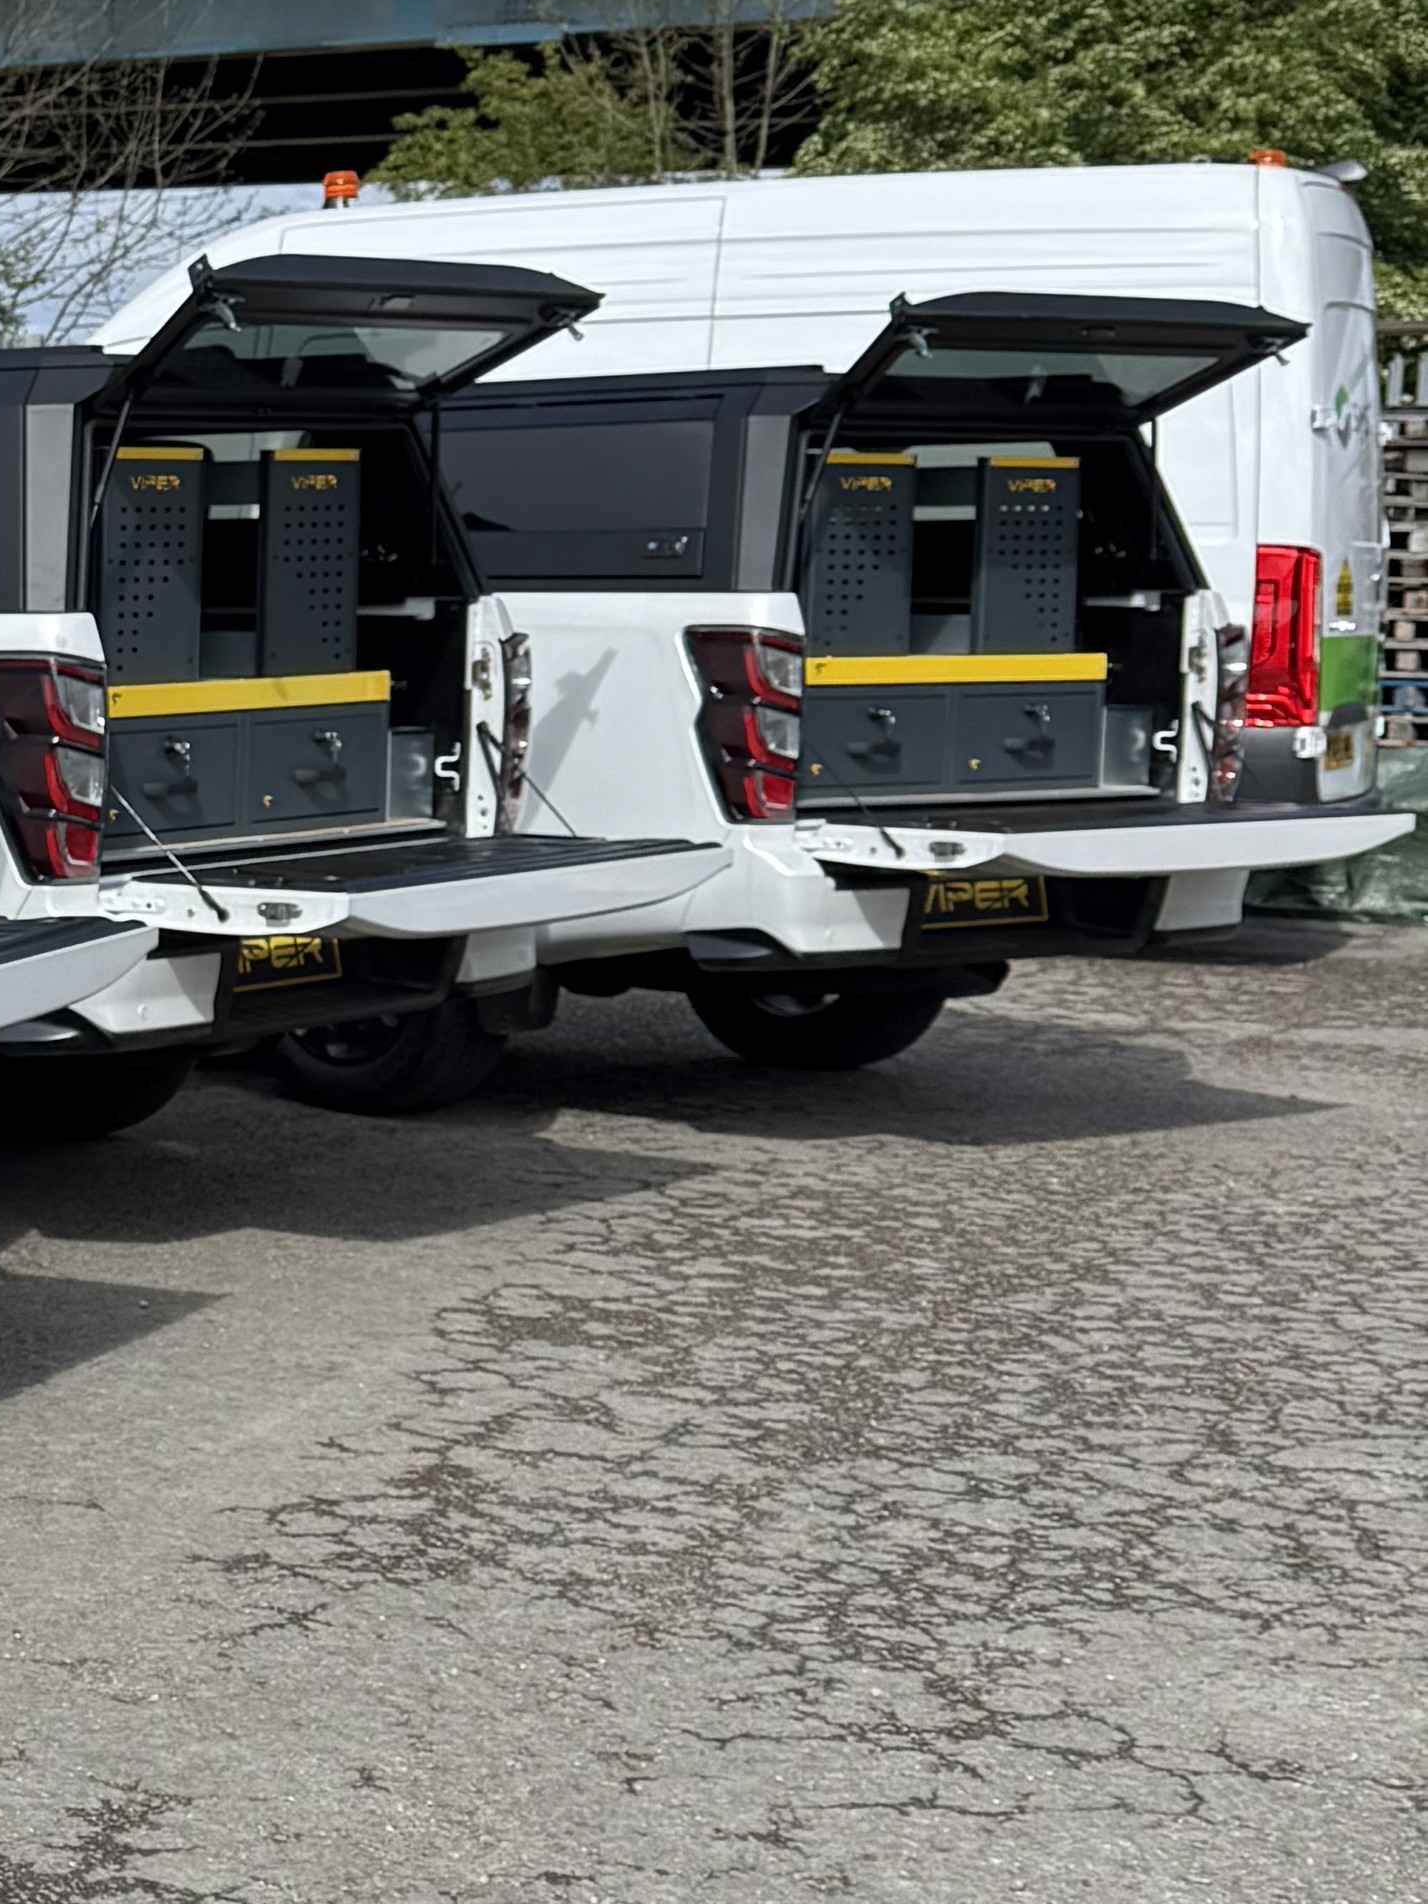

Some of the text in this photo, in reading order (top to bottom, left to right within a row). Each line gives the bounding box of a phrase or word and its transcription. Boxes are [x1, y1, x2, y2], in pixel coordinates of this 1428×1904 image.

[130, 474, 181, 492] VIPER
[291, 474, 338, 491] VIPER
[840, 476, 892, 492] VIPER
[1007, 477, 1057, 494] VIPER
[237, 935, 324, 976] IPER
